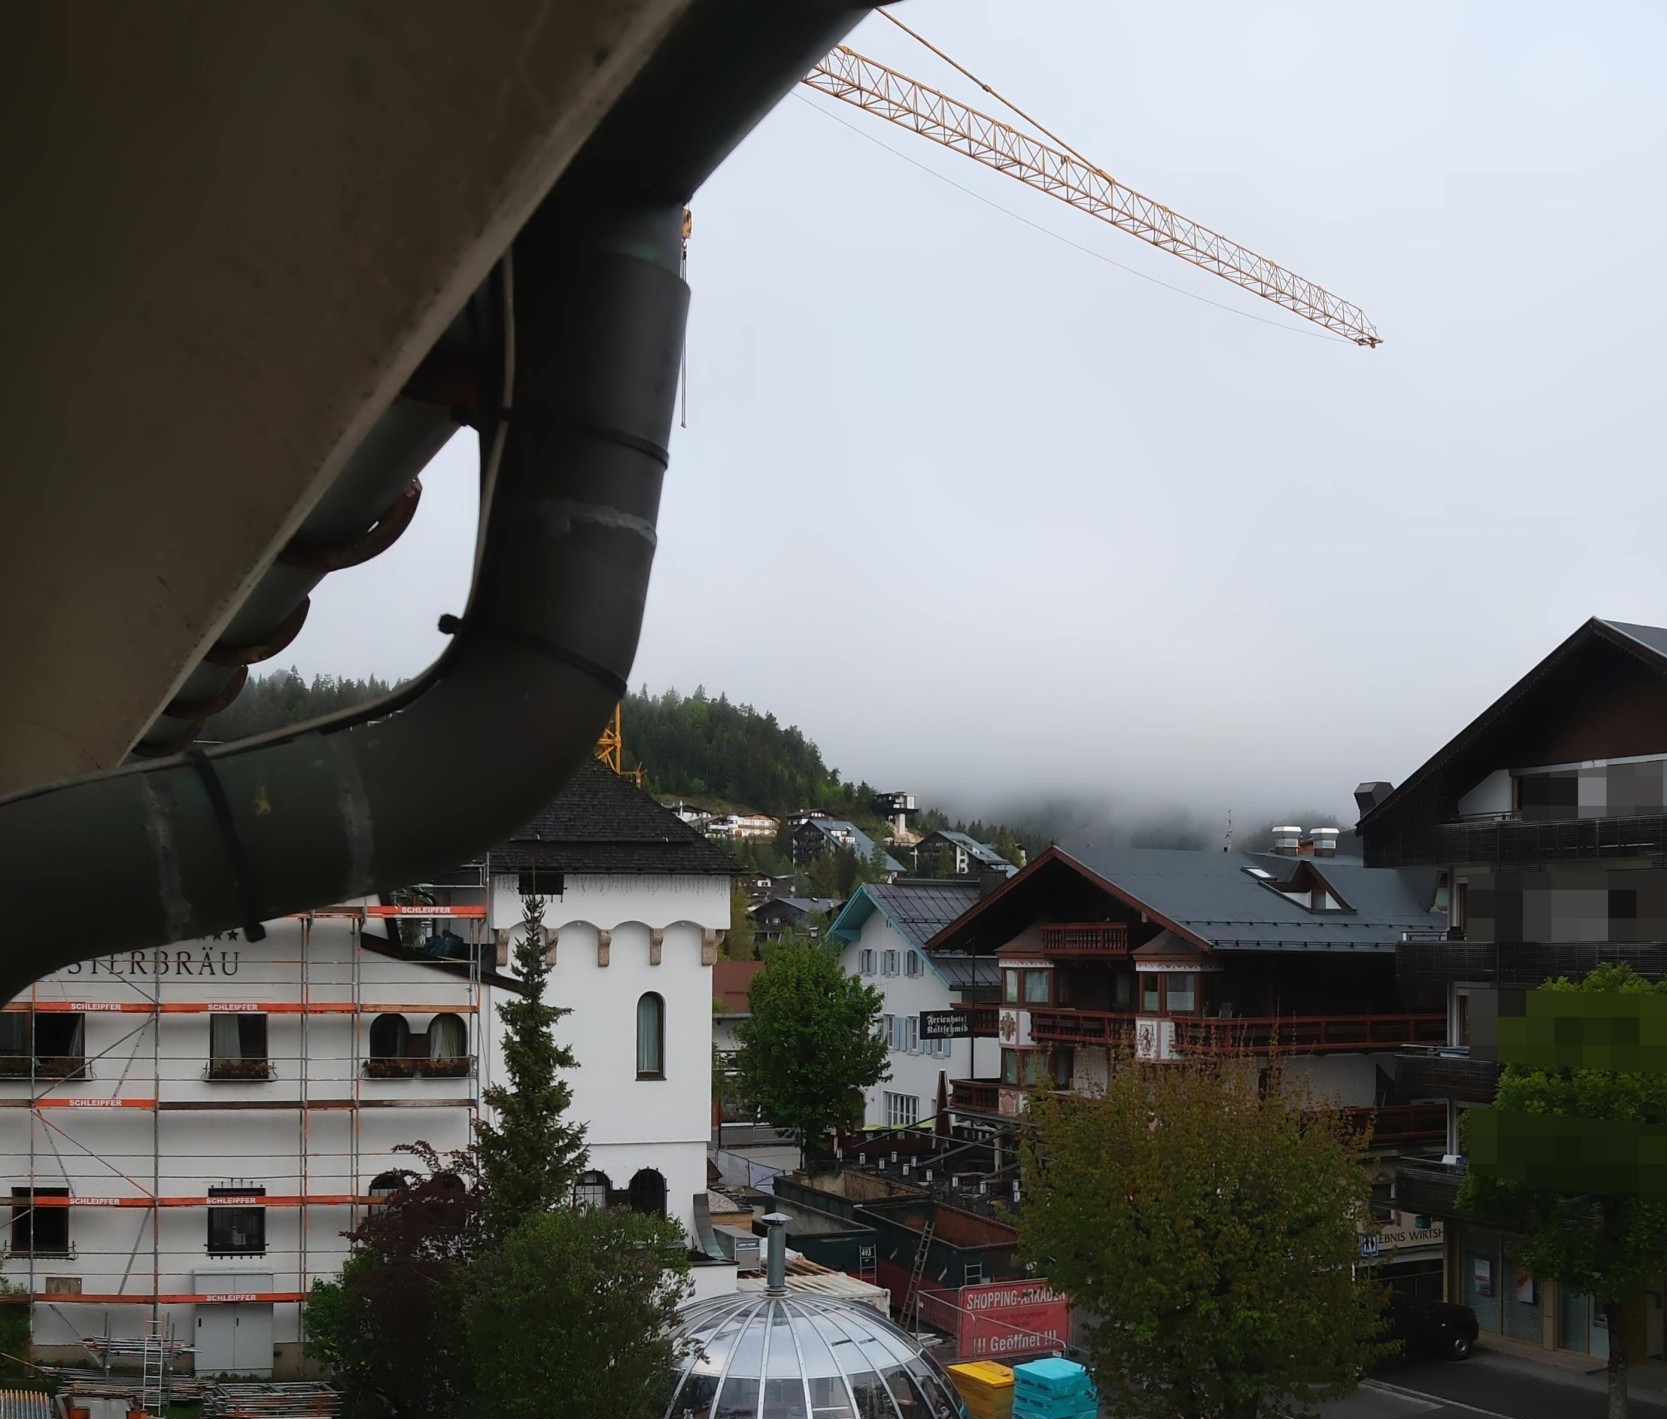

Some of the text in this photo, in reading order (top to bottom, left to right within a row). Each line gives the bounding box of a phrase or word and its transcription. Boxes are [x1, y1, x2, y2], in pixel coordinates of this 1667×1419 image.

[401, 906, 451, 914] SCHLEIPFER
[70, 1003, 122, 1011] SCHLEIPFER
[69, 1099, 122, 1107] SCHLEIPFER
[206, 1294, 257, 1302] SCHLEIPFER
[990, 1332, 1041, 1352] Geöffnet
